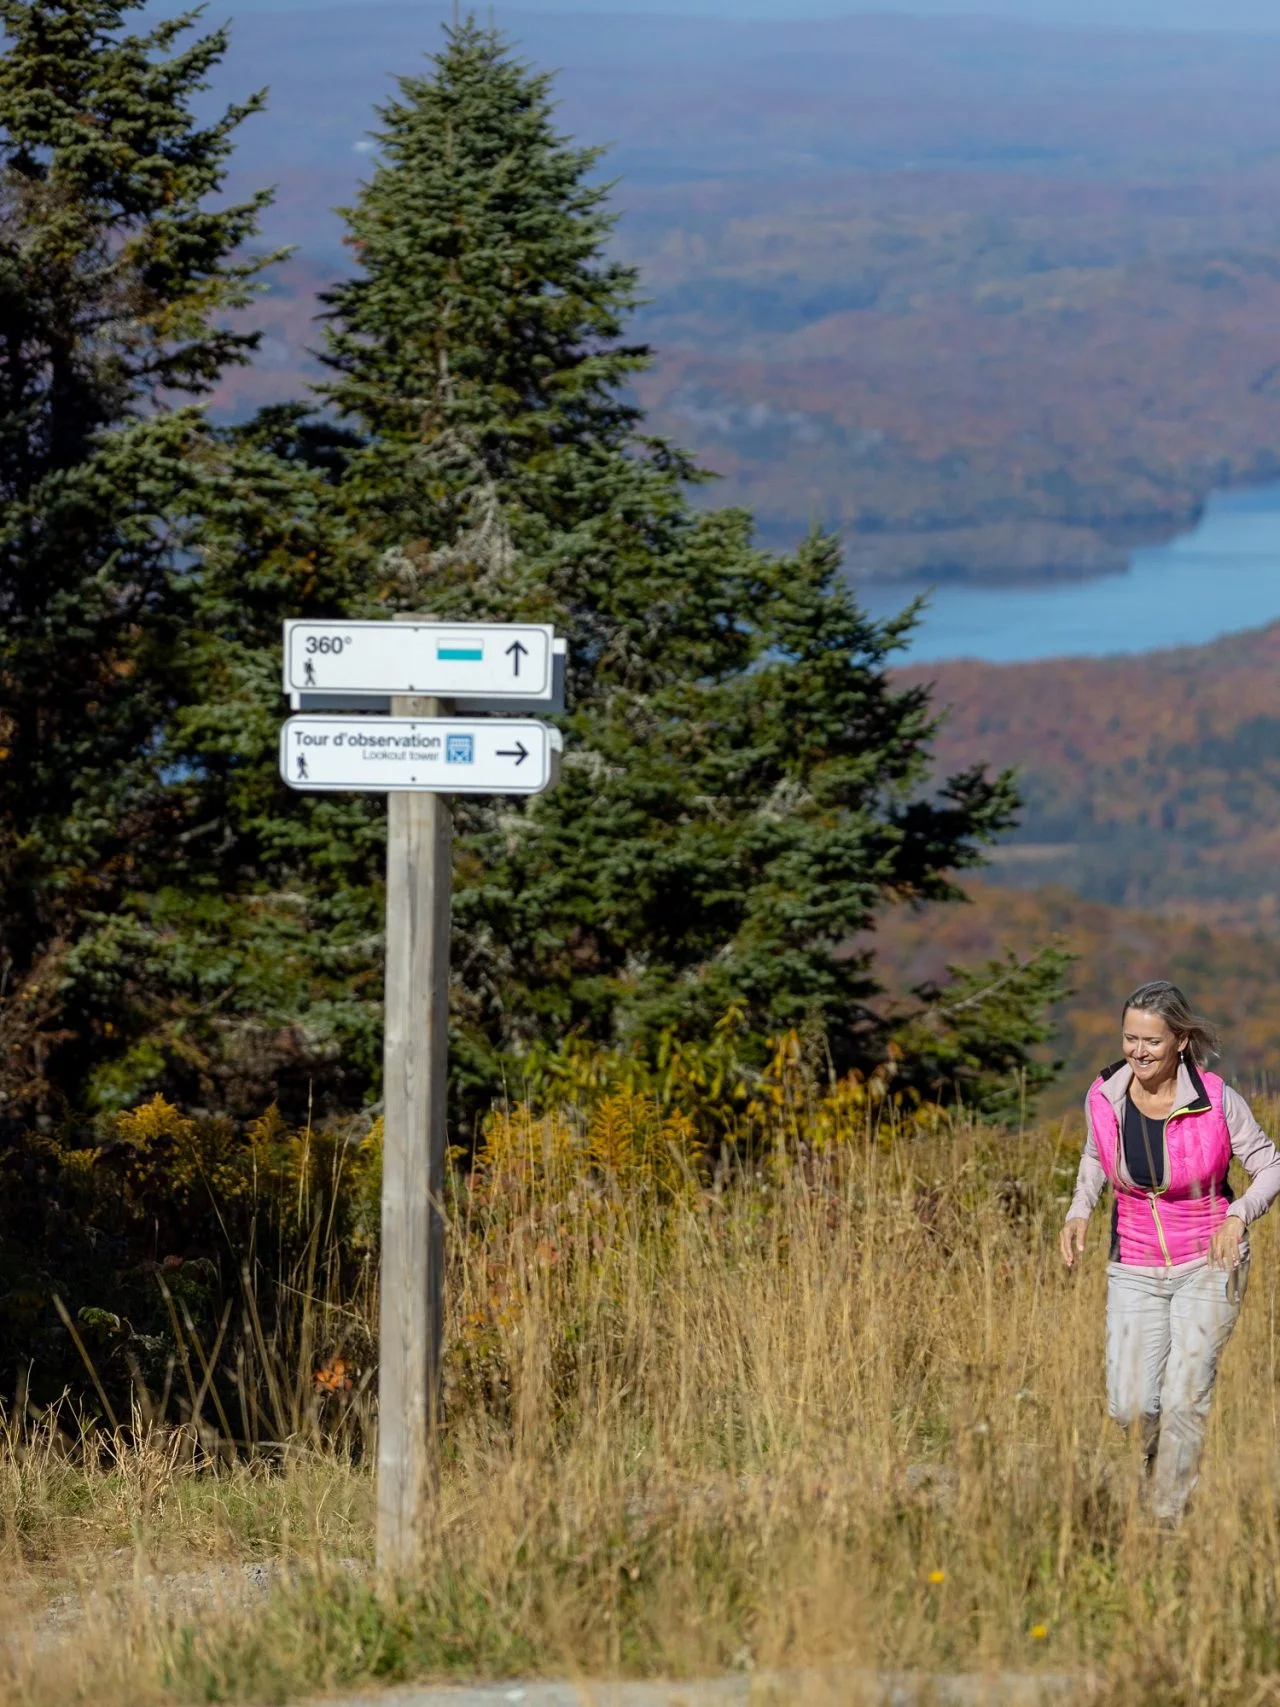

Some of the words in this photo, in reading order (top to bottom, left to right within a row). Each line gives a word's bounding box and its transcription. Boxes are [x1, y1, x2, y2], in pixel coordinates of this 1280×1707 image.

[305, 636, 352, 655] 360°
[294, 731, 329, 747] Tour
[333, 732, 441, 748] d'observation
[362, 750, 406, 761] Lookout
[409, 750, 439, 761] tower
